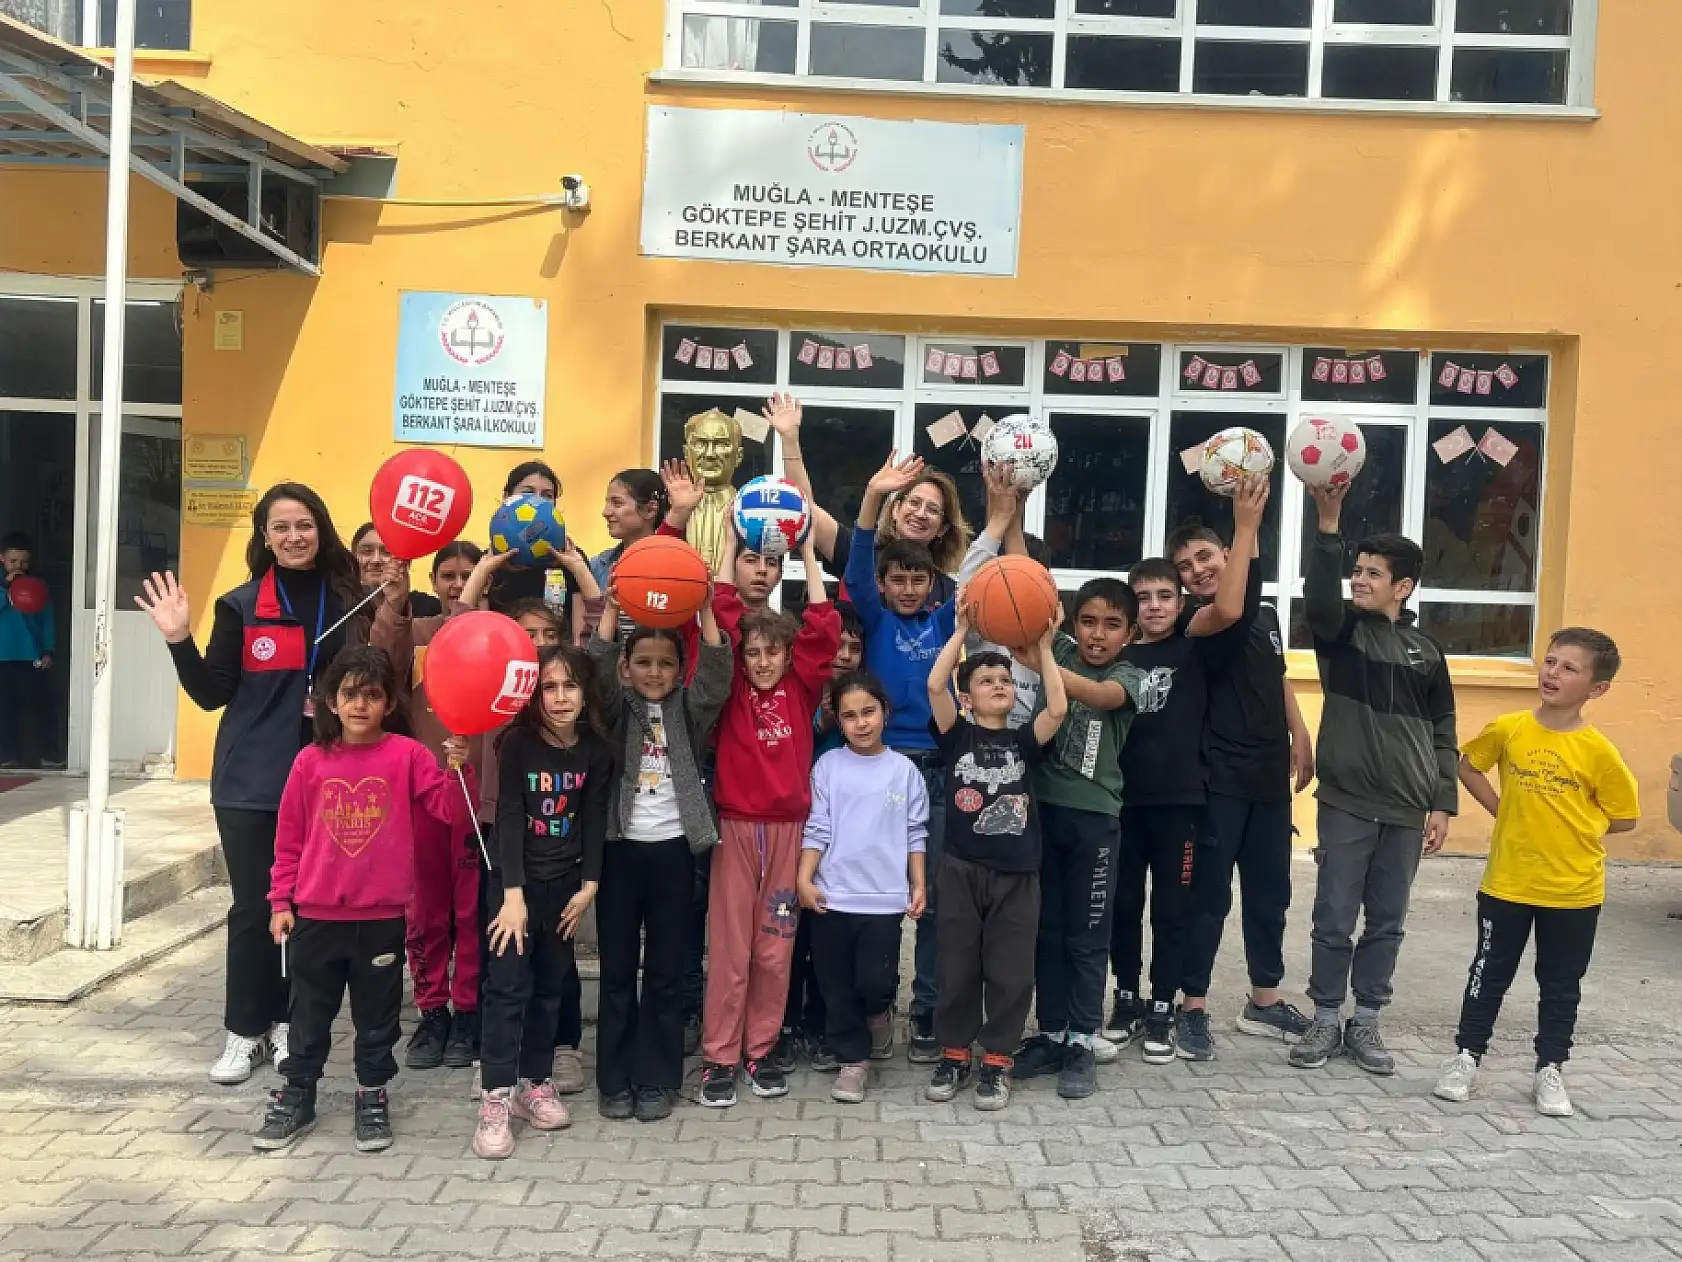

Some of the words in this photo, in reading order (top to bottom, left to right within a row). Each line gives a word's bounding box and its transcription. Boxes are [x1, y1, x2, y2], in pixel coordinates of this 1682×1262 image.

[732, 182, 812, 206] MUĞLA
[830, 190, 935, 215] MENTEŞE
[682, 203, 787, 228] GÖKTEPE
[793, 209, 857, 233] ŞEHİT
[862, 216, 983, 242] J.UZM.ÇVŞ.
[674, 229, 781, 252] BERKANT
[786, 236, 847, 258] ŞARA
[852, 240, 987, 264] ORTAOKULU
[423, 375, 460, 393] MUĞLA
[469, 380, 517, 398] MENTEŞE
[400, 394, 448, 411] GÖKTEPE
[451, 397, 481, 414] ŞEHİT
[484, 400, 539, 418] J.UZM.ÇVŞ.
[402, 414, 451, 430] BERKANT
[453, 417, 483, 434] ŞARA
[484, 416, 536, 435] İLKOKULU
[1014, 433, 1033, 449] 112
[408, 482, 446, 513] 112
[758, 488, 781, 504] 112
[646, 591, 669, 610] 112
[527, 772, 587, 792] TRICK
